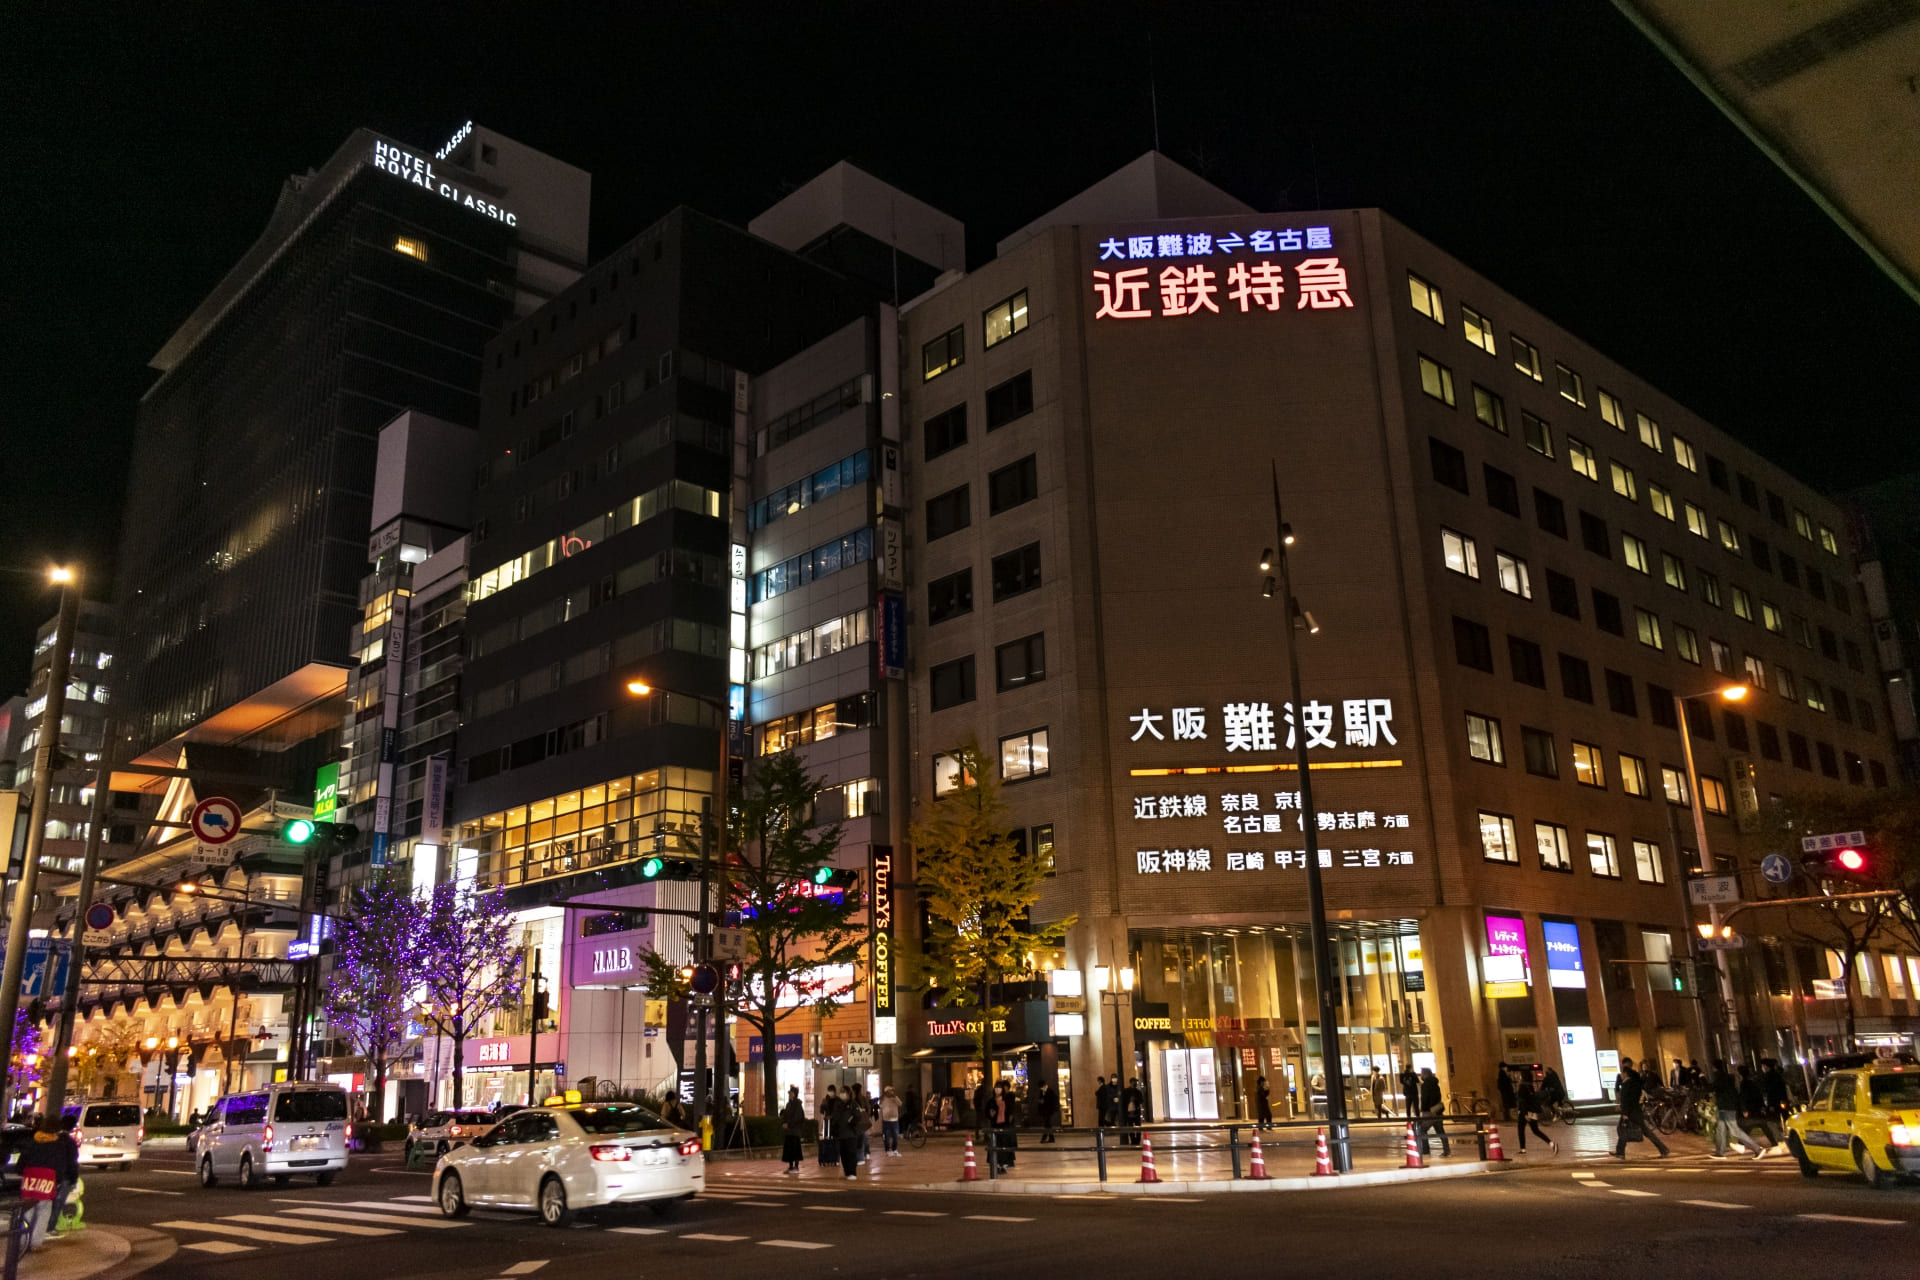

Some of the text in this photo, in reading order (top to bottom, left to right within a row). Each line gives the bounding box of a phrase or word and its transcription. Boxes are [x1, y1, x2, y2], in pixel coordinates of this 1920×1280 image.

[376, 140, 435, 178] HOTEL
[374, 155, 434, 191] ROYAL
[1100, 226, 1333, 261] 大阪難波 名古屋
[1093, 257, 1354, 320] 近鉄特急
[1129, 699, 1398, 752] 大阪難波駅
[316, 784, 336, 802] レイク
[1134, 795, 1208, 819] 近鉄線
[1221, 793, 1260, 812] 奈良
[314, 798, 335, 816] ALSA
[1223, 814, 1282, 834] 名古屋
[1382, 815, 1409, 829] 方面
[1804, 833, 1862, 850] 時差信号
[1137, 848, 1211, 874] 阪神線
[1226, 852, 1264, 871] 尼崎
[1343, 849, 1381, 868] 三宮
[1387, 852, 1413, 866] 方面
[876, 931, 889, 1008] COFFEE
[966, 1020, 1007, 1034] COEE
[1135, 1017, 1171, 1030] COFFEE
